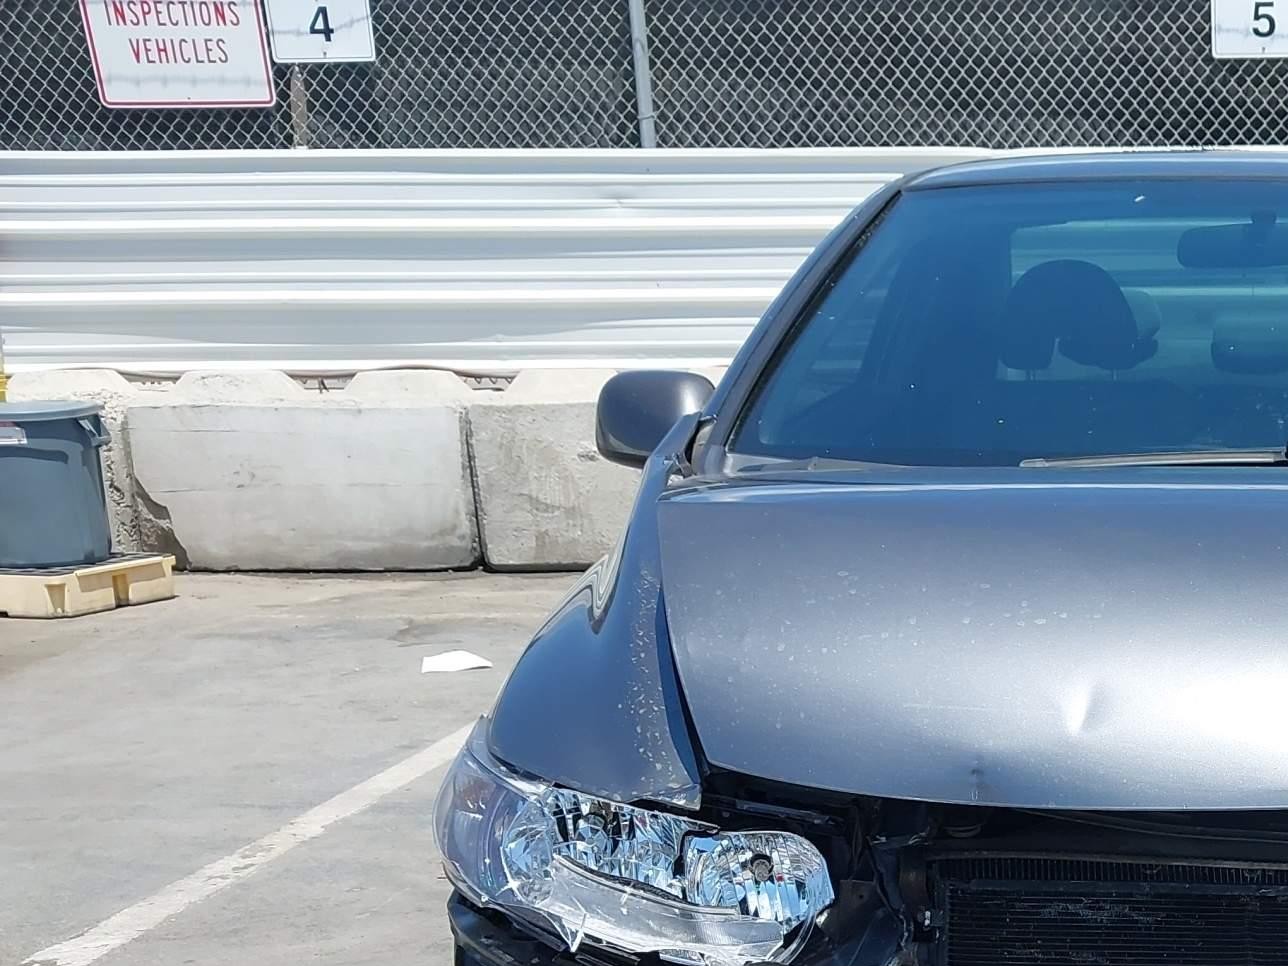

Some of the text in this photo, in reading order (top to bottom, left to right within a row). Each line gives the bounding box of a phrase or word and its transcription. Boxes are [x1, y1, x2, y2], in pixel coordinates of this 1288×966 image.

[103, 0, 240, 26] INSPECTIONS
[309, 6, 335, 42] 4
[1252, 2, 1276, 38] 5
[128, 38, 229, 64] VEHICLES
